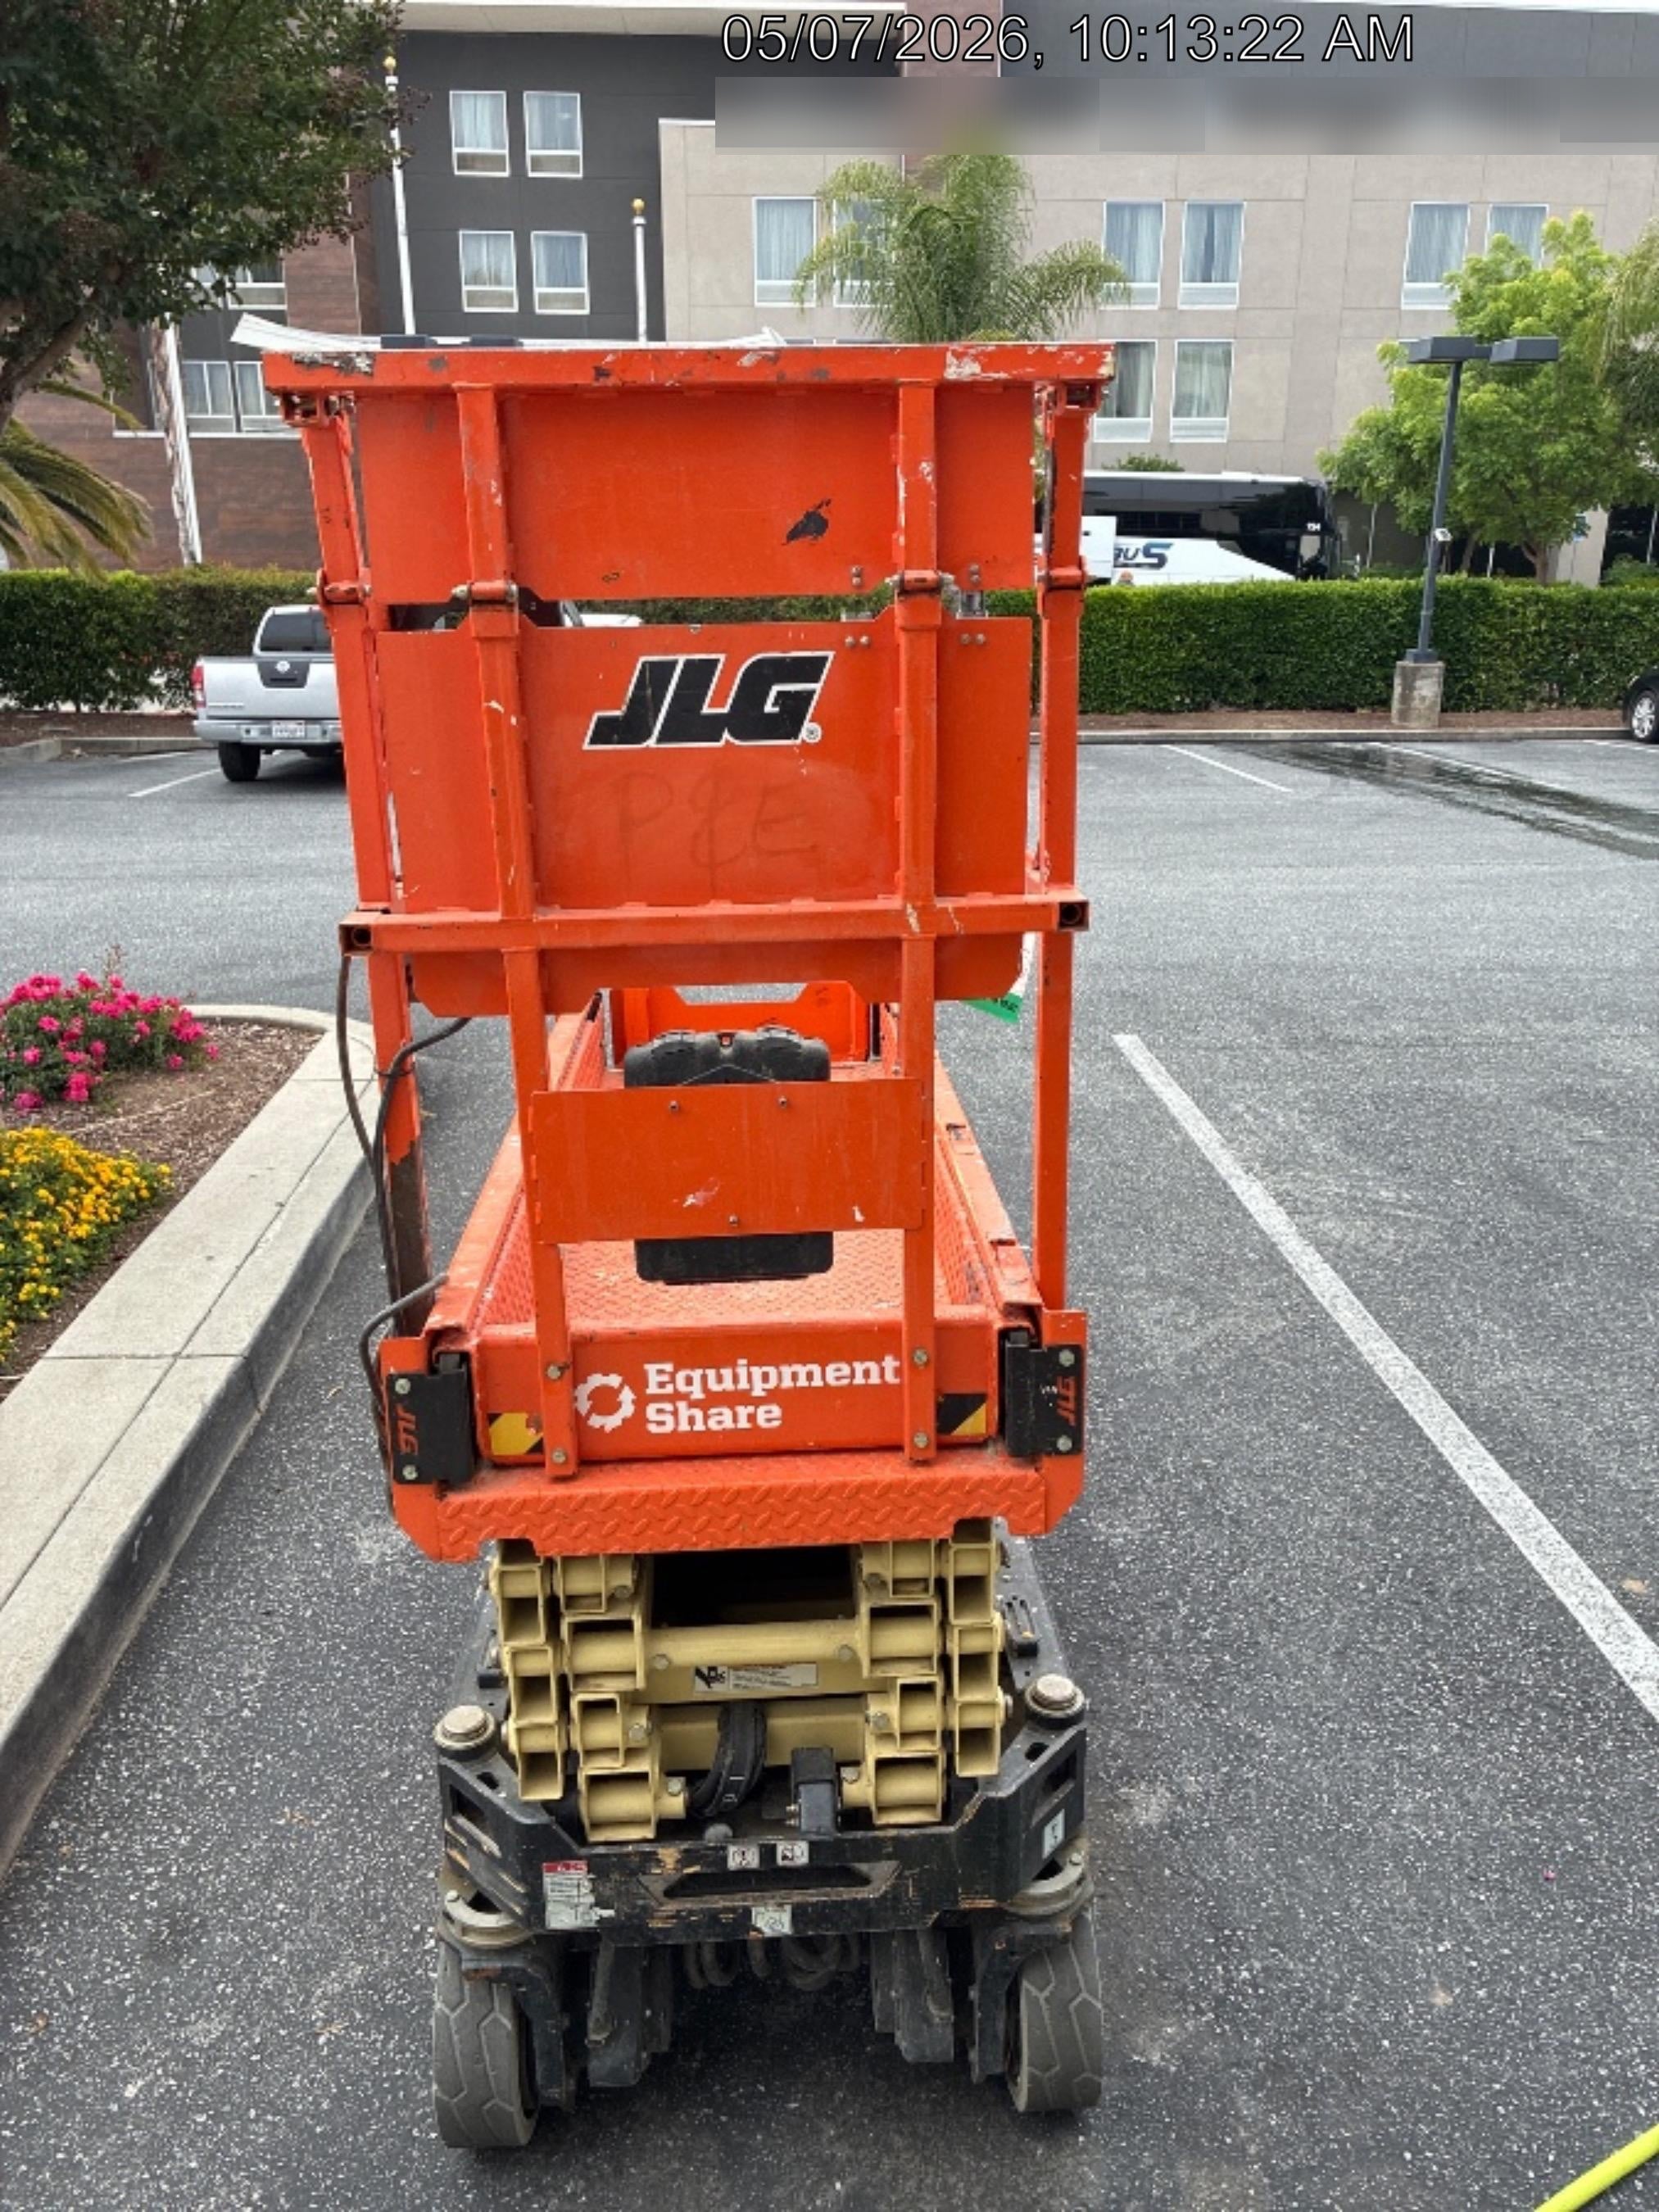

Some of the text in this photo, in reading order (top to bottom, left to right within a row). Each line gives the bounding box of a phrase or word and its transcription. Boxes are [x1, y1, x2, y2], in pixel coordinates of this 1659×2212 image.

[582, 651, 836, 750] JLG
[644, 1354, 901, 1400] Equipment
[1056, 1376, 1077, 1427] JLG
[394, 1403, 419, 1456] JLG
[646, 1401, 782, 1434] Share
